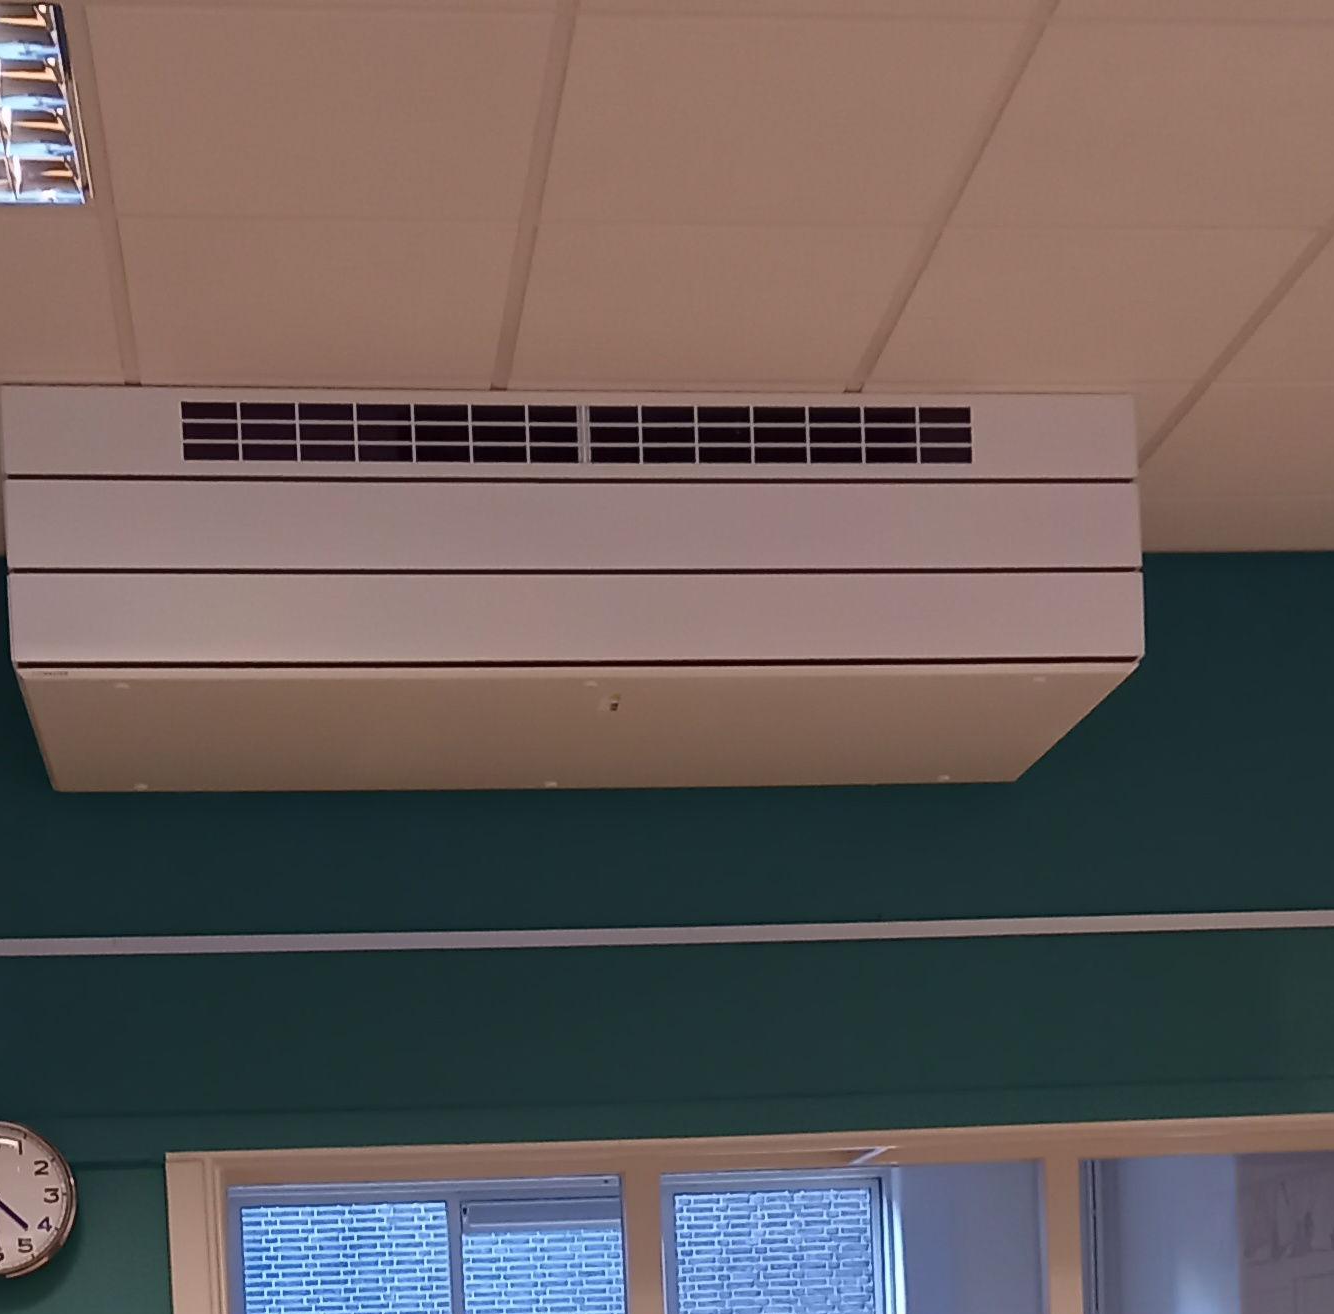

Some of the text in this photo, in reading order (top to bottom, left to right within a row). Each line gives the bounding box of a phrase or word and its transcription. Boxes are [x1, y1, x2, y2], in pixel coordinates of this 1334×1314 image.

[34, 1161, 49, 1176] 2
[44, 1188, 59, 1203] 3
[38, 1216, 52, 1232] 4
[18, 1238, 33, 1253] 5
